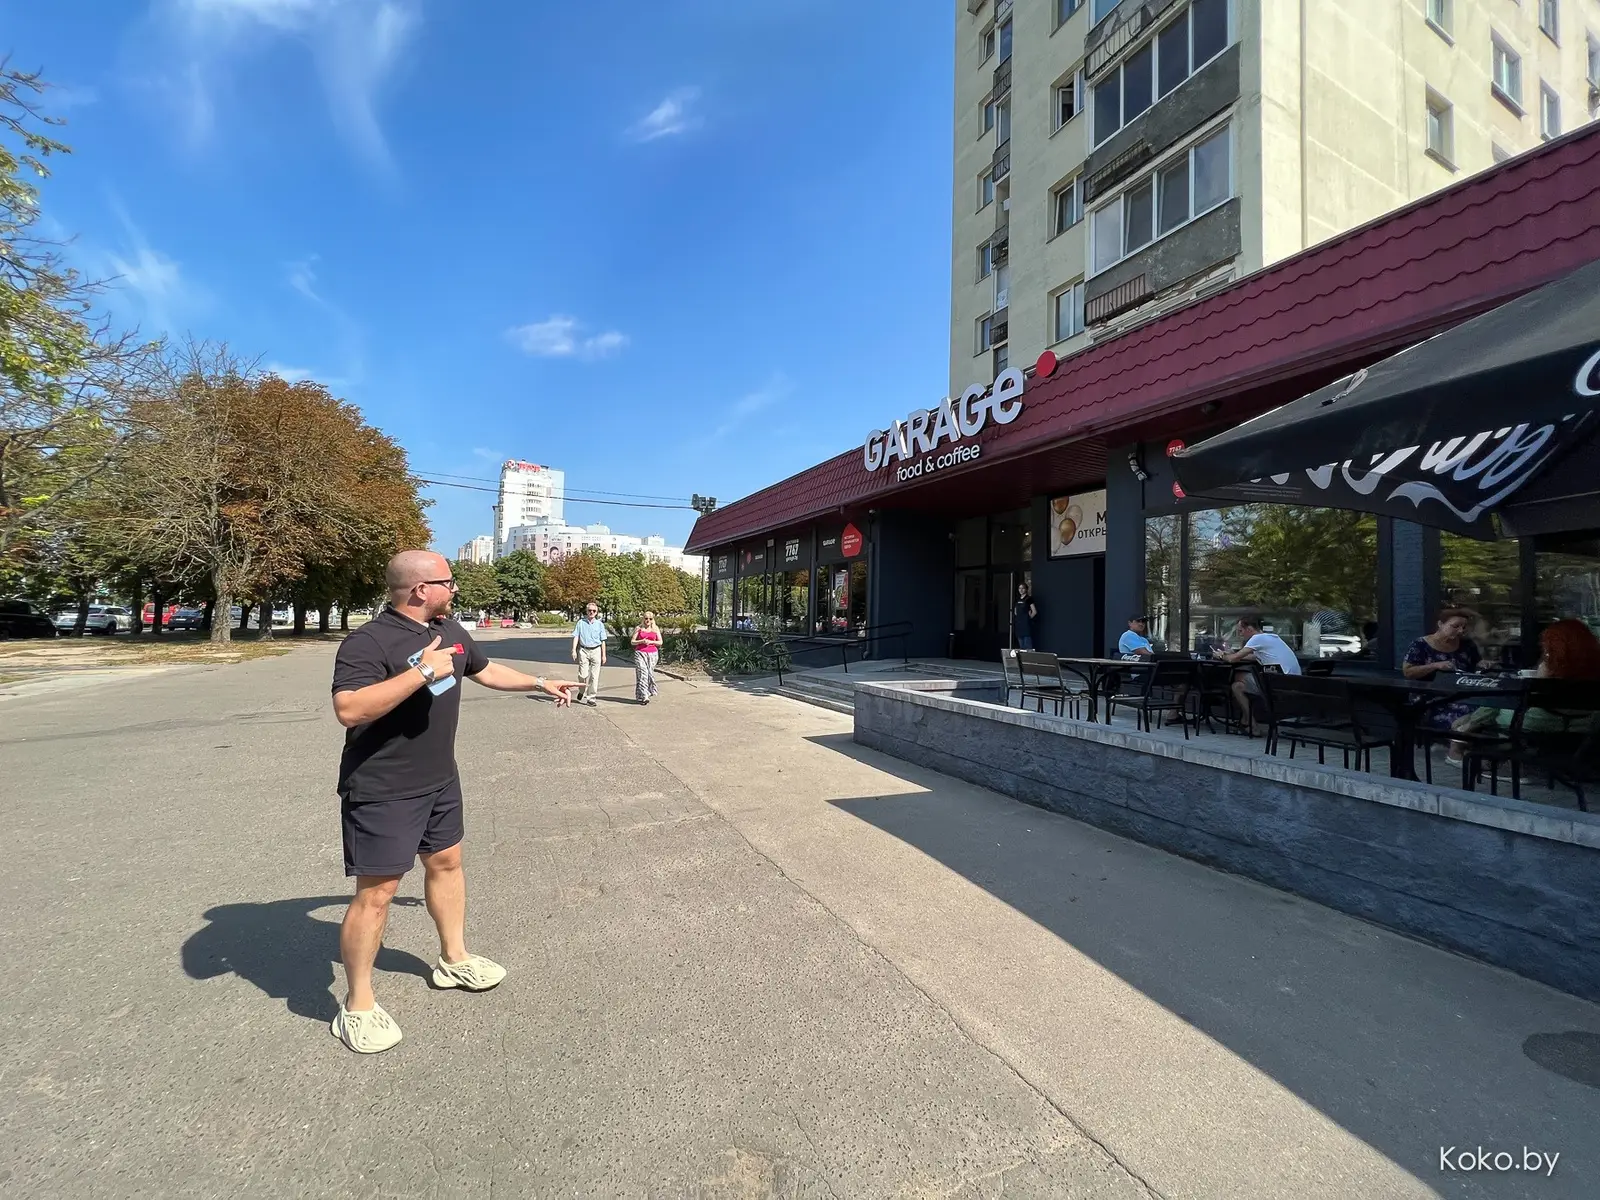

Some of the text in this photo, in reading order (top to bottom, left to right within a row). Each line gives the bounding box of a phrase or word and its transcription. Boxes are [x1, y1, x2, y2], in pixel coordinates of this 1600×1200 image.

[897, 444, 980, 482] food & coffee
